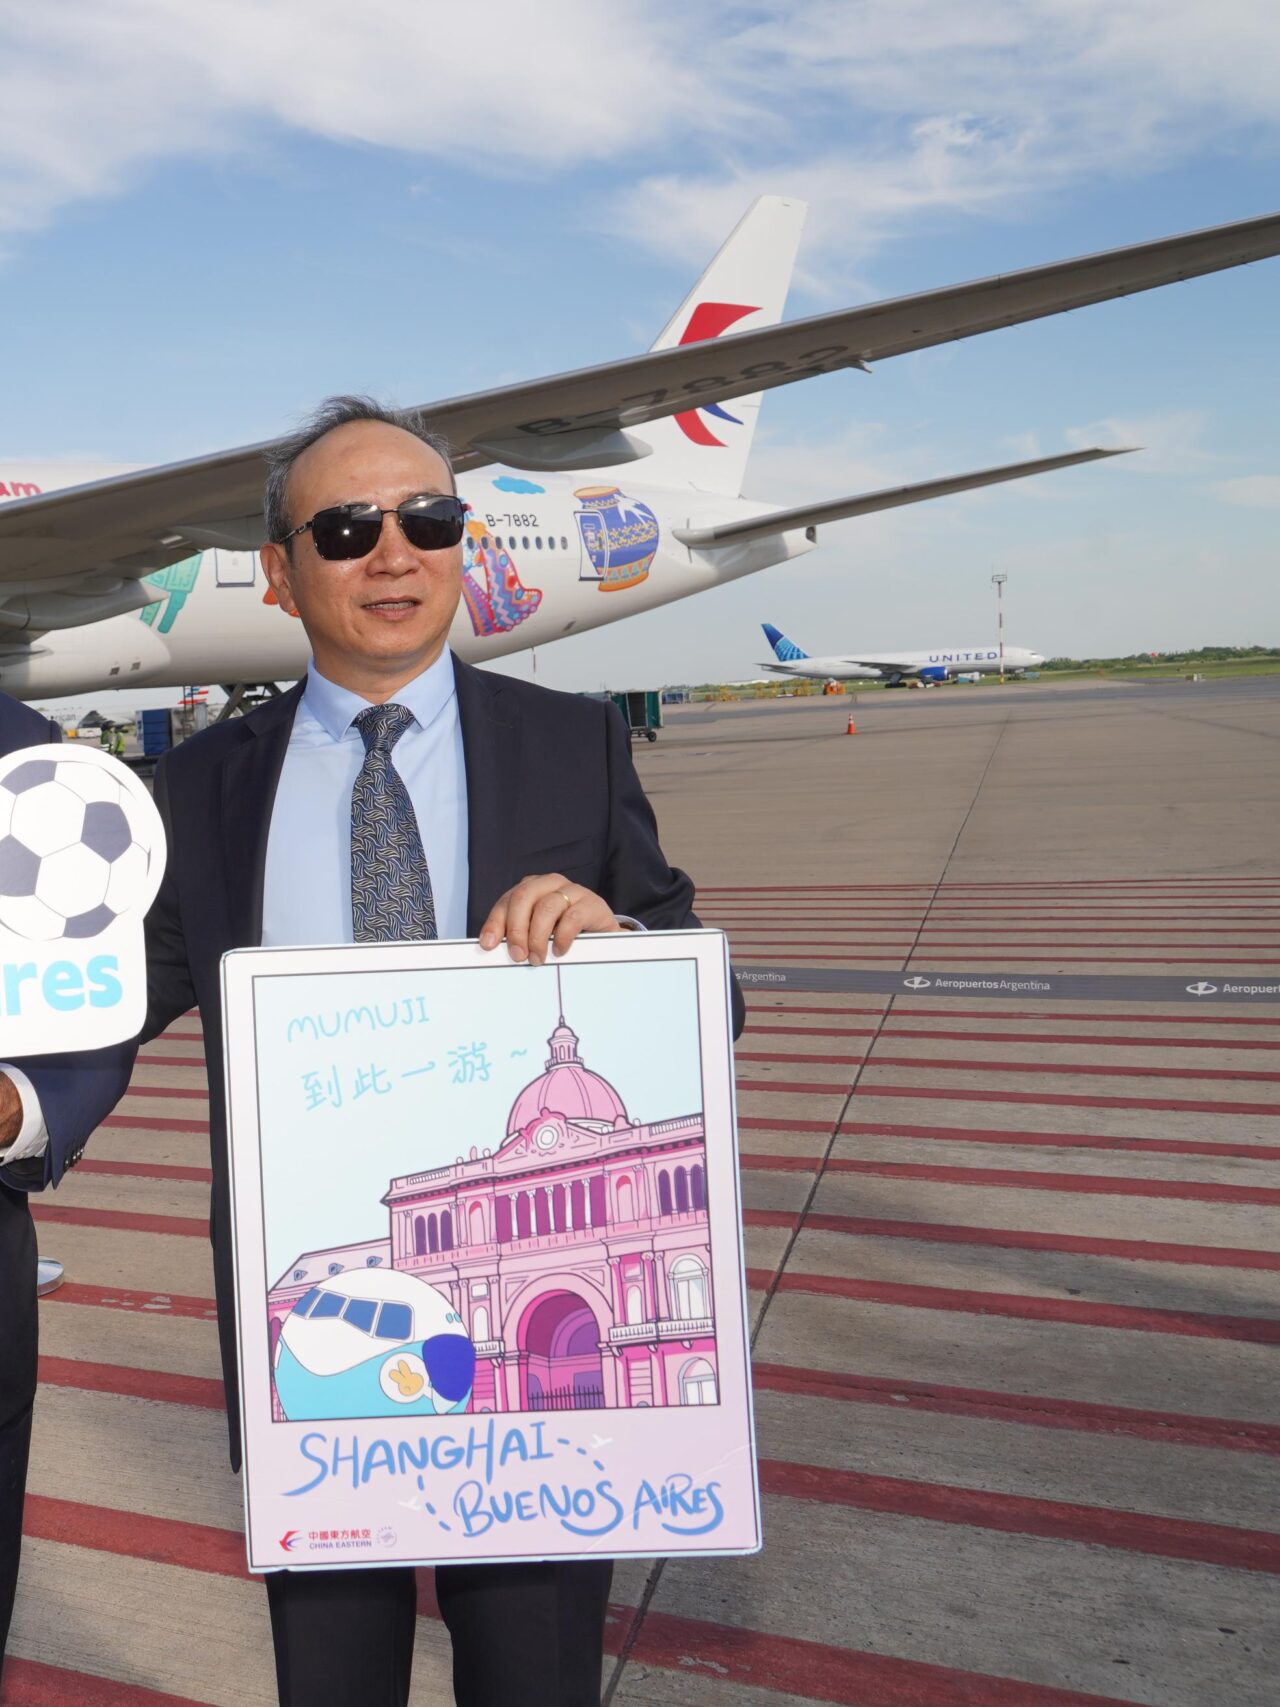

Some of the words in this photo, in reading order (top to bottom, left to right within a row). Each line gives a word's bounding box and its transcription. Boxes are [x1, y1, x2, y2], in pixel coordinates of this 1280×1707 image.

[486, 514, 539, 527] B-7882
[928, 651, 998, 663] UNITED
[287, 996, 430, 1043] MUMUJI
[280, 1418, 554, 1496] SHANGHAI
[453, 1480, 625, 1537] BUENOS
[632, 1473, 725, 1536] AIRES
[309, 1541, 334, 1550] CHINA
[335, 1540, 372, 1549] EASTERN
